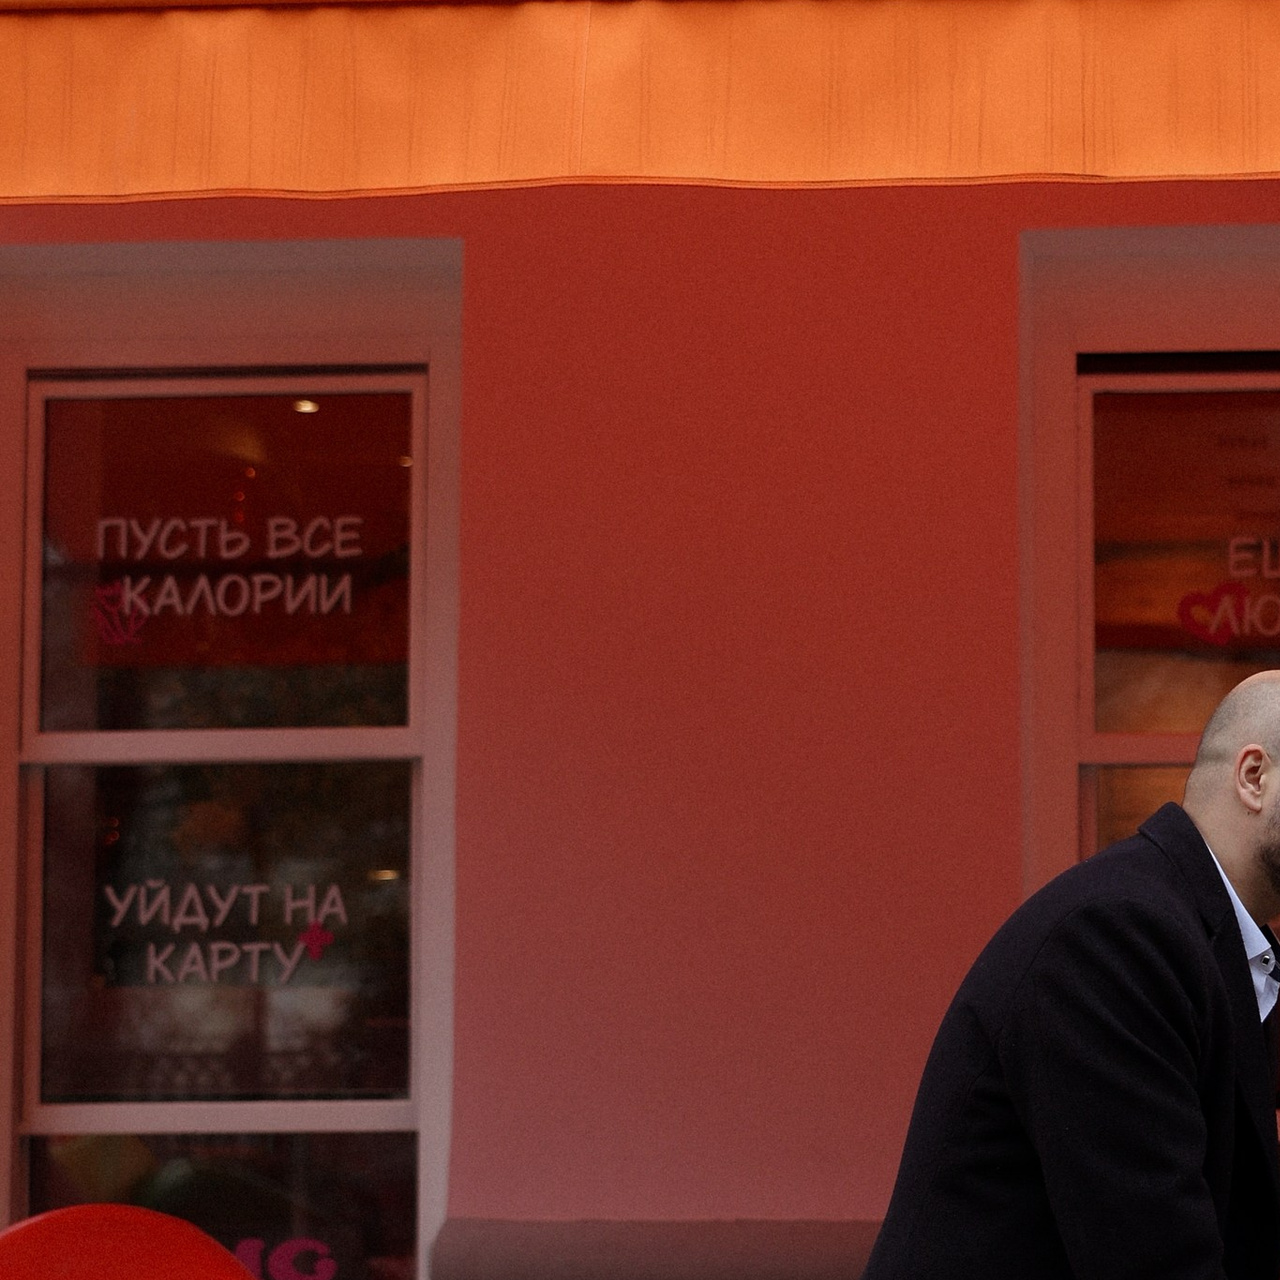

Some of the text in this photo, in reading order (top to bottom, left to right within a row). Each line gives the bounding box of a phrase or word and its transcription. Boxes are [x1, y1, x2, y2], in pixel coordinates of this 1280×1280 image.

[97, 516, 363, 560] ПУСТЬ ВСЕ
[121, 573, 352, 617] КАЛОРИИ
[104, 879, 349, 933] УЙДУТ НА
[146, 940, 306, 984] КАРТУ
